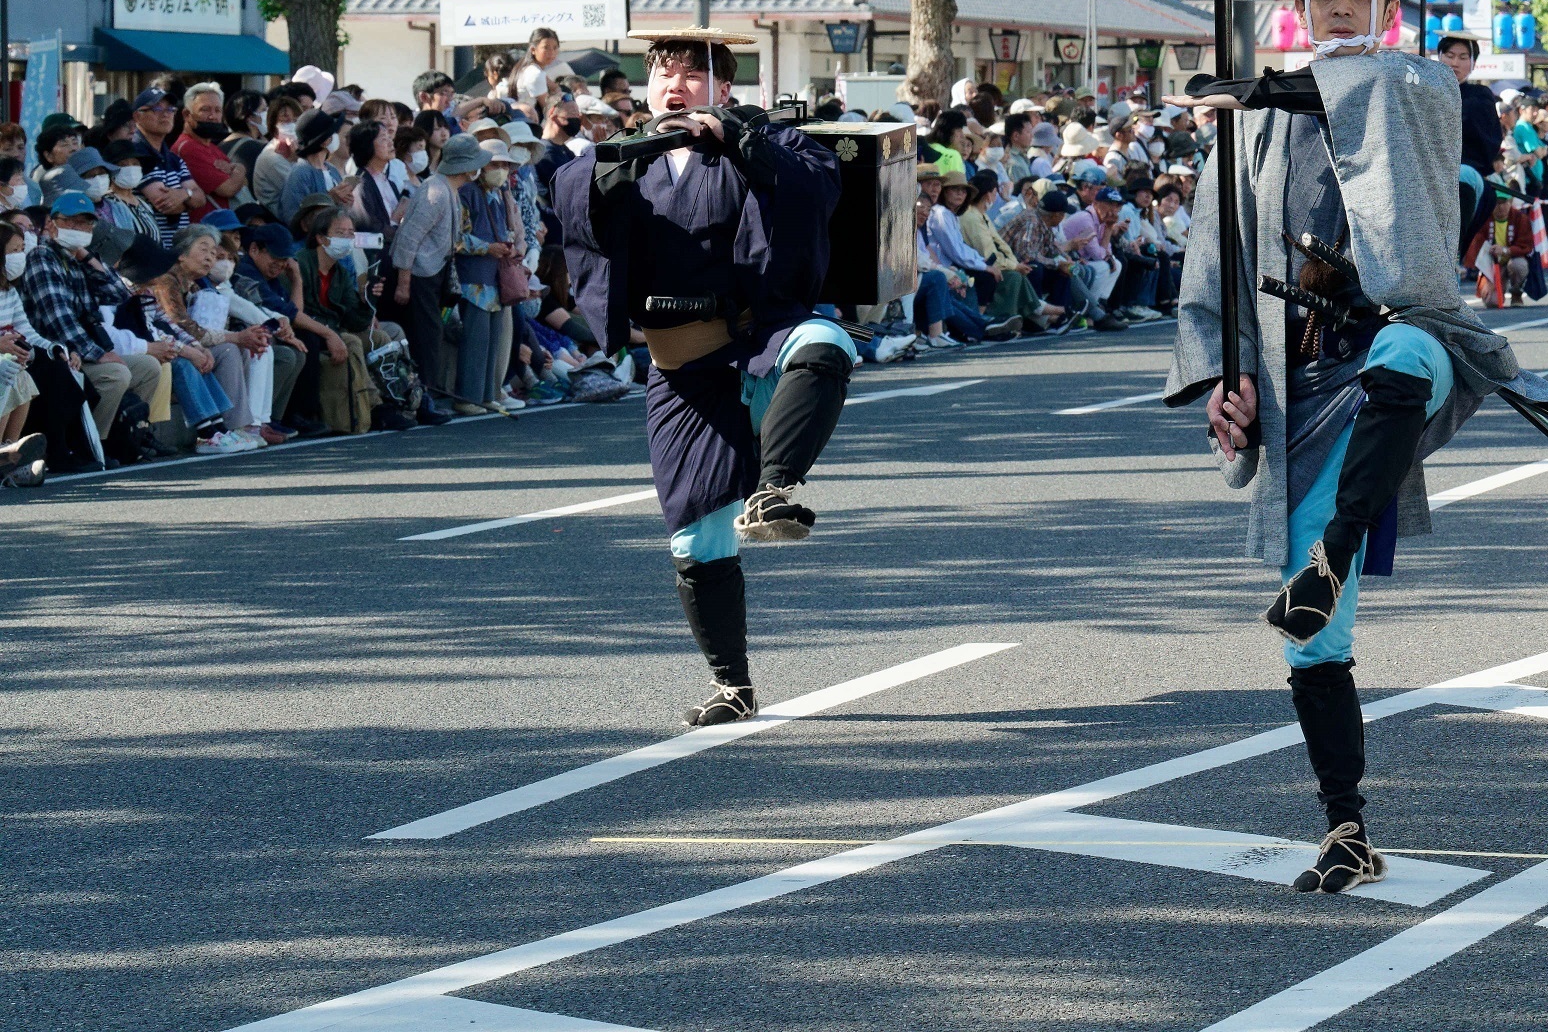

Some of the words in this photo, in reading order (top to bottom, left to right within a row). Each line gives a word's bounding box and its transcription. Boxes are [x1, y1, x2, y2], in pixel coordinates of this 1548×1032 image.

[481, 13, 574, 26] 城山ホールディングス
